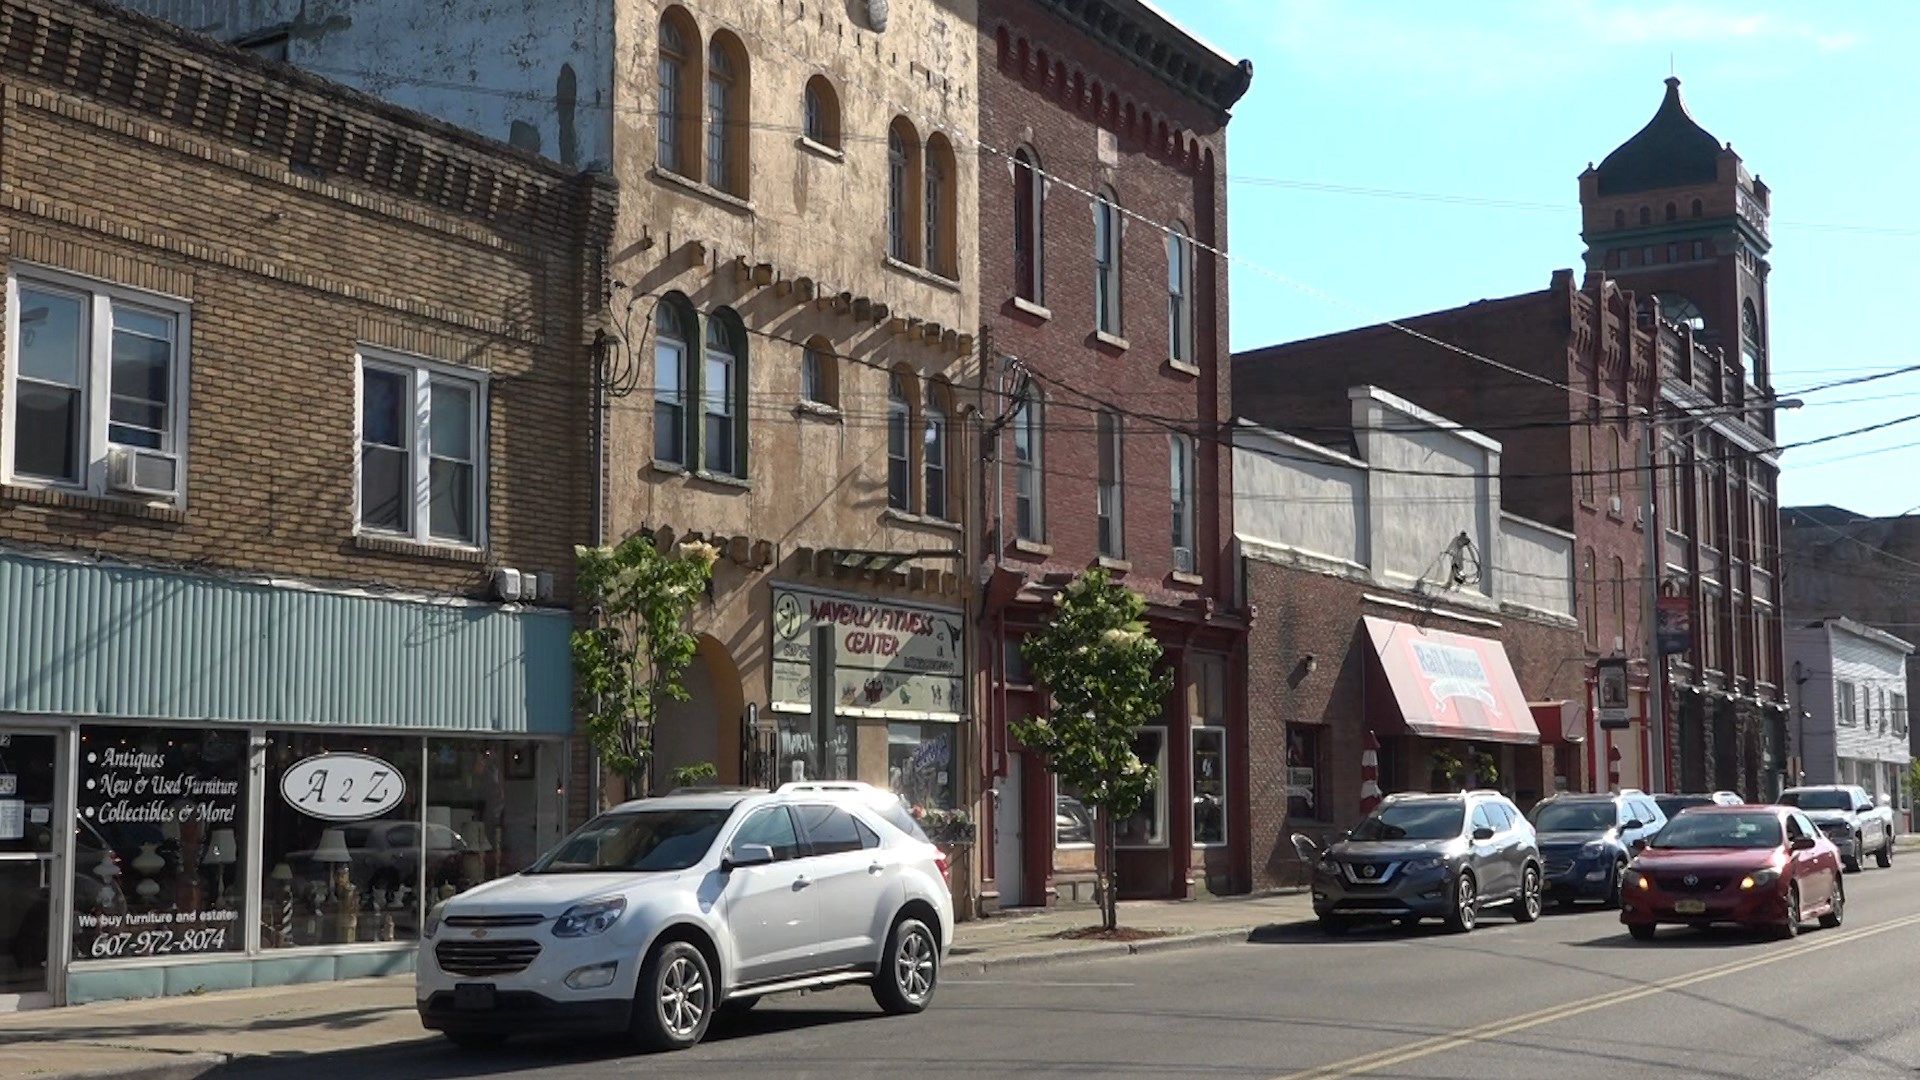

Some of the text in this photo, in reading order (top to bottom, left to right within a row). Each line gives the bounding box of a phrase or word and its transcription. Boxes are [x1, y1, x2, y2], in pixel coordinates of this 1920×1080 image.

[809, 597, 934, 636] WAVERLY FITNESS
[844, 630, 899, 656] CENTER
[101, 747, 166, 775] Antiques
[100, 771, 239, 799] New & Used Furniture
[298, 769, 389, 804] A 2 Z
[98, 799, 237, 825] Collectibles & More!
[78, 908, 239, 927] We buy furniture and estates
[91, 927, 226, 958] 607-972-8074
